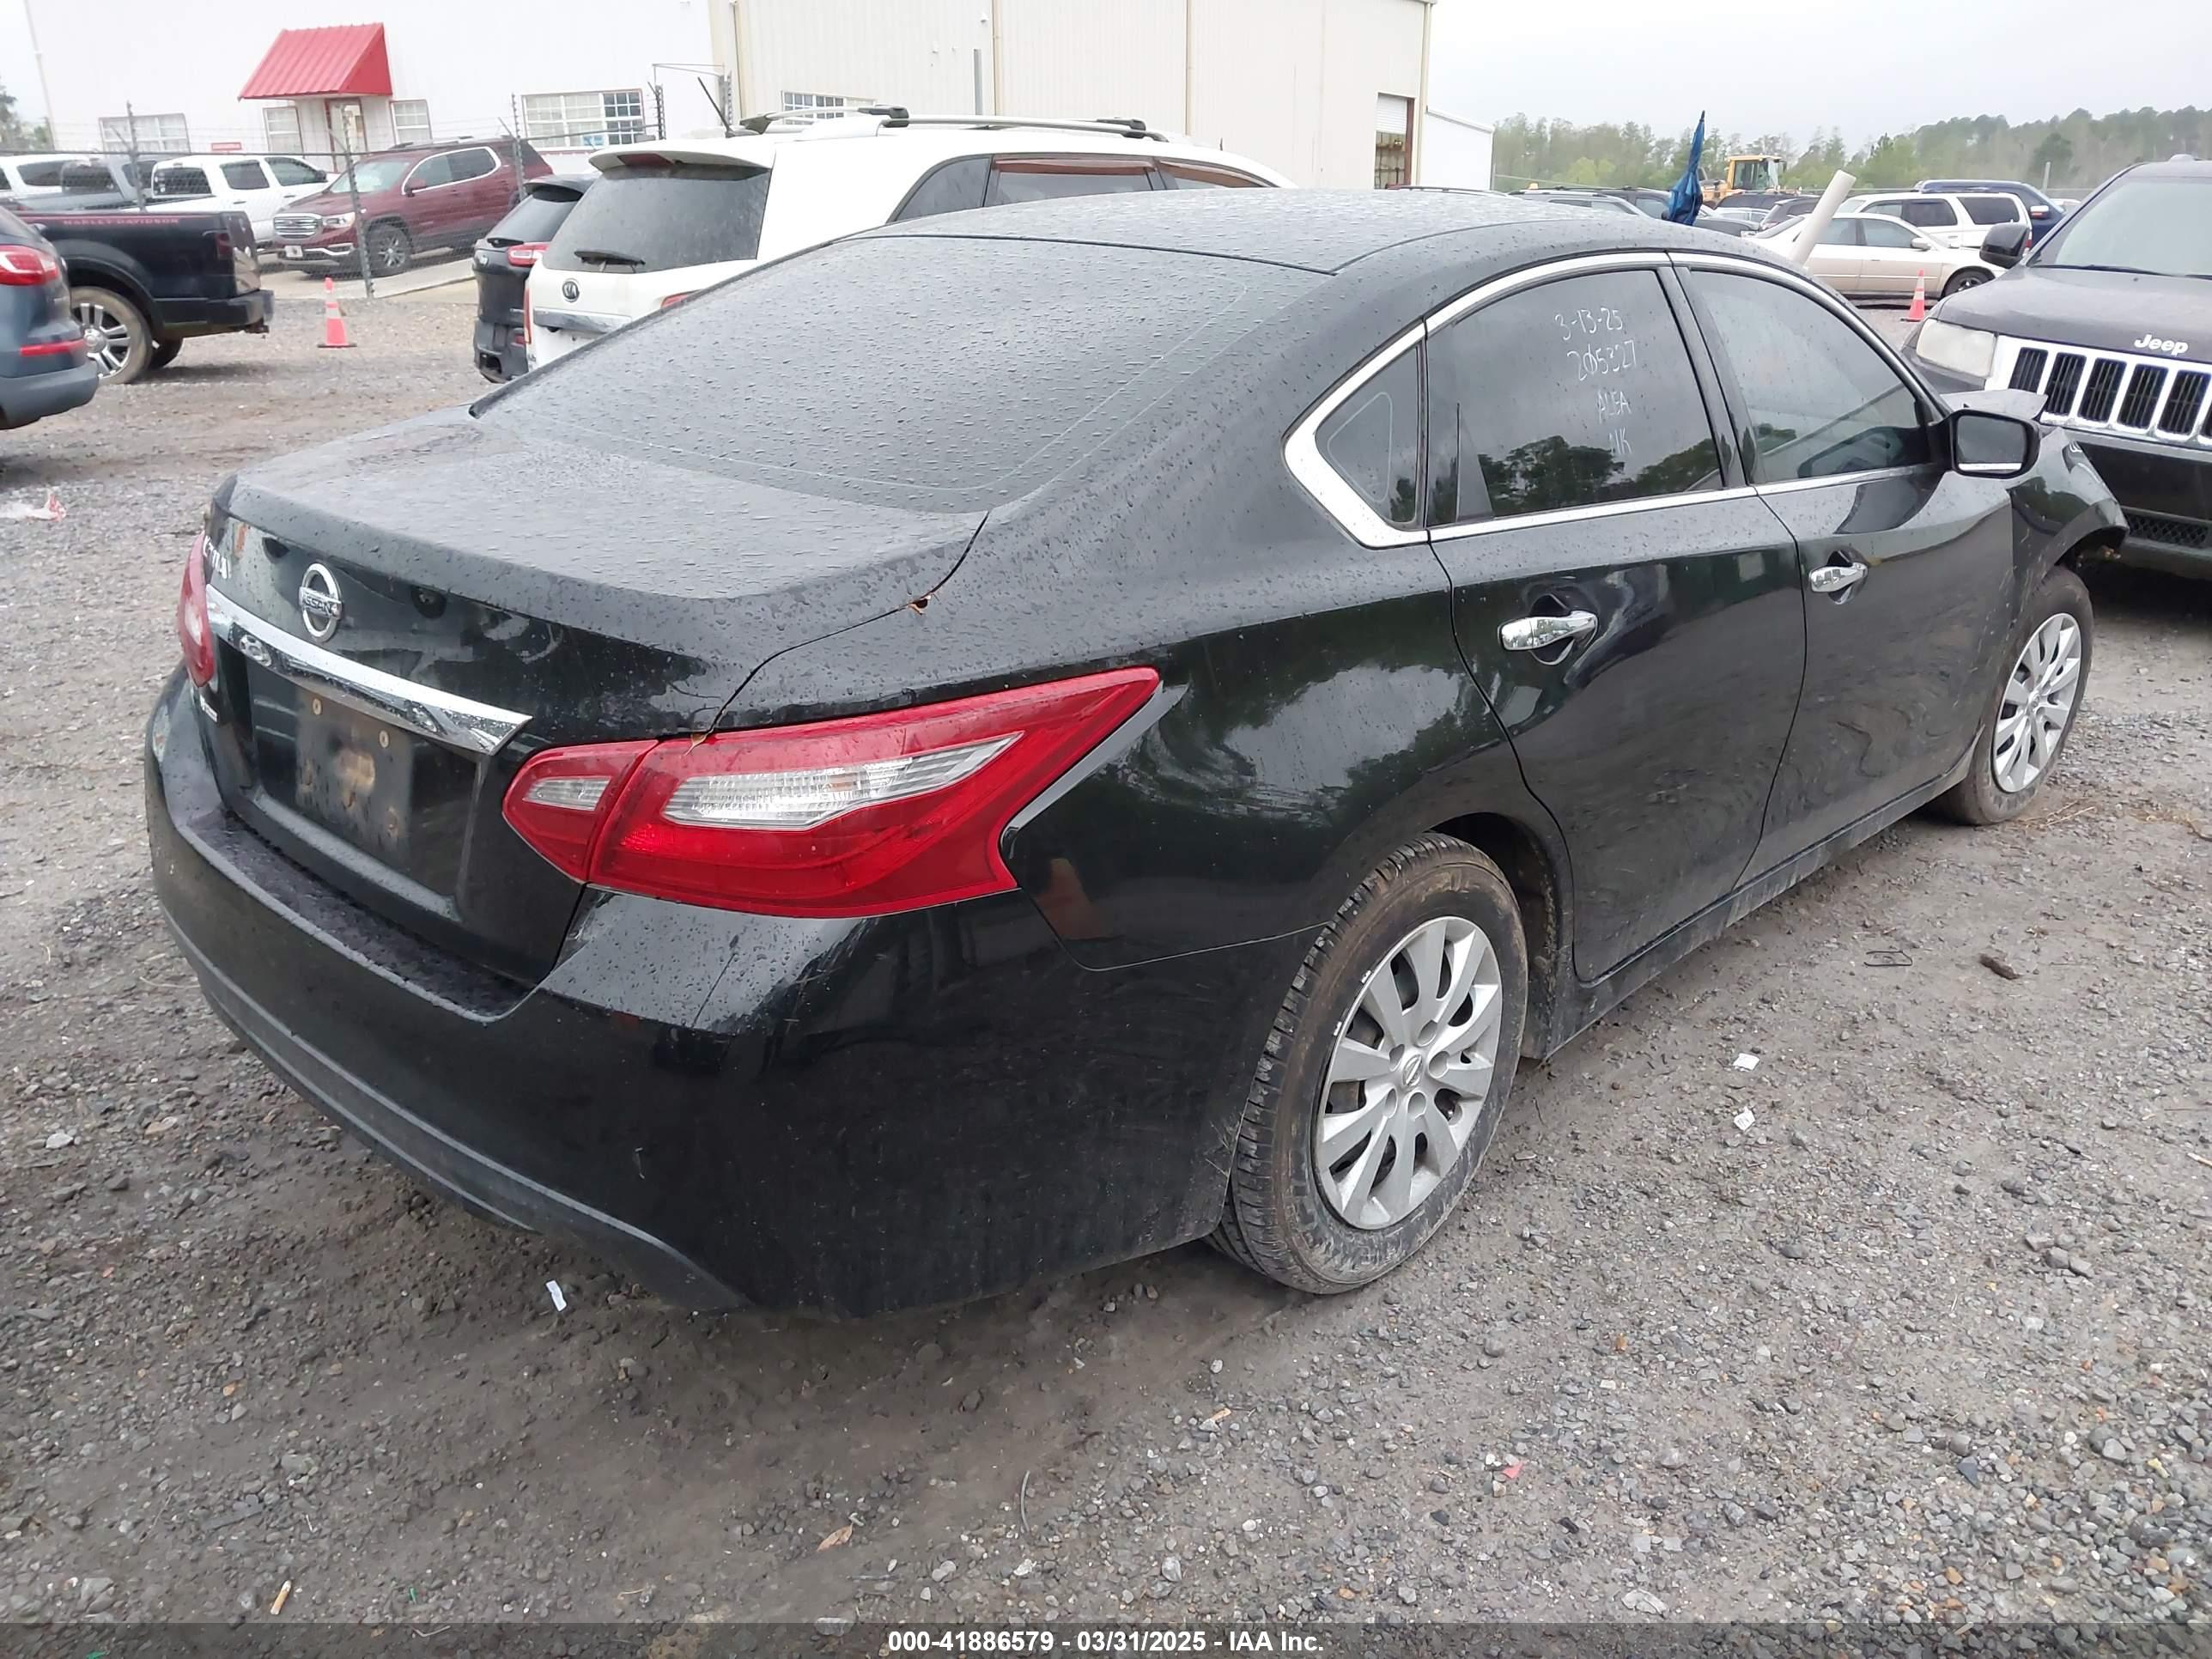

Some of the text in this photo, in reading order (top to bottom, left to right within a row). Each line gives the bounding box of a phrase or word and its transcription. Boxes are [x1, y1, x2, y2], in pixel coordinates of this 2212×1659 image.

[1555, 307, 1623, 340] 3-13-25
[2134, 334, 2189, 356] Jeep
[301, 590, 333, 616] ISSAN
